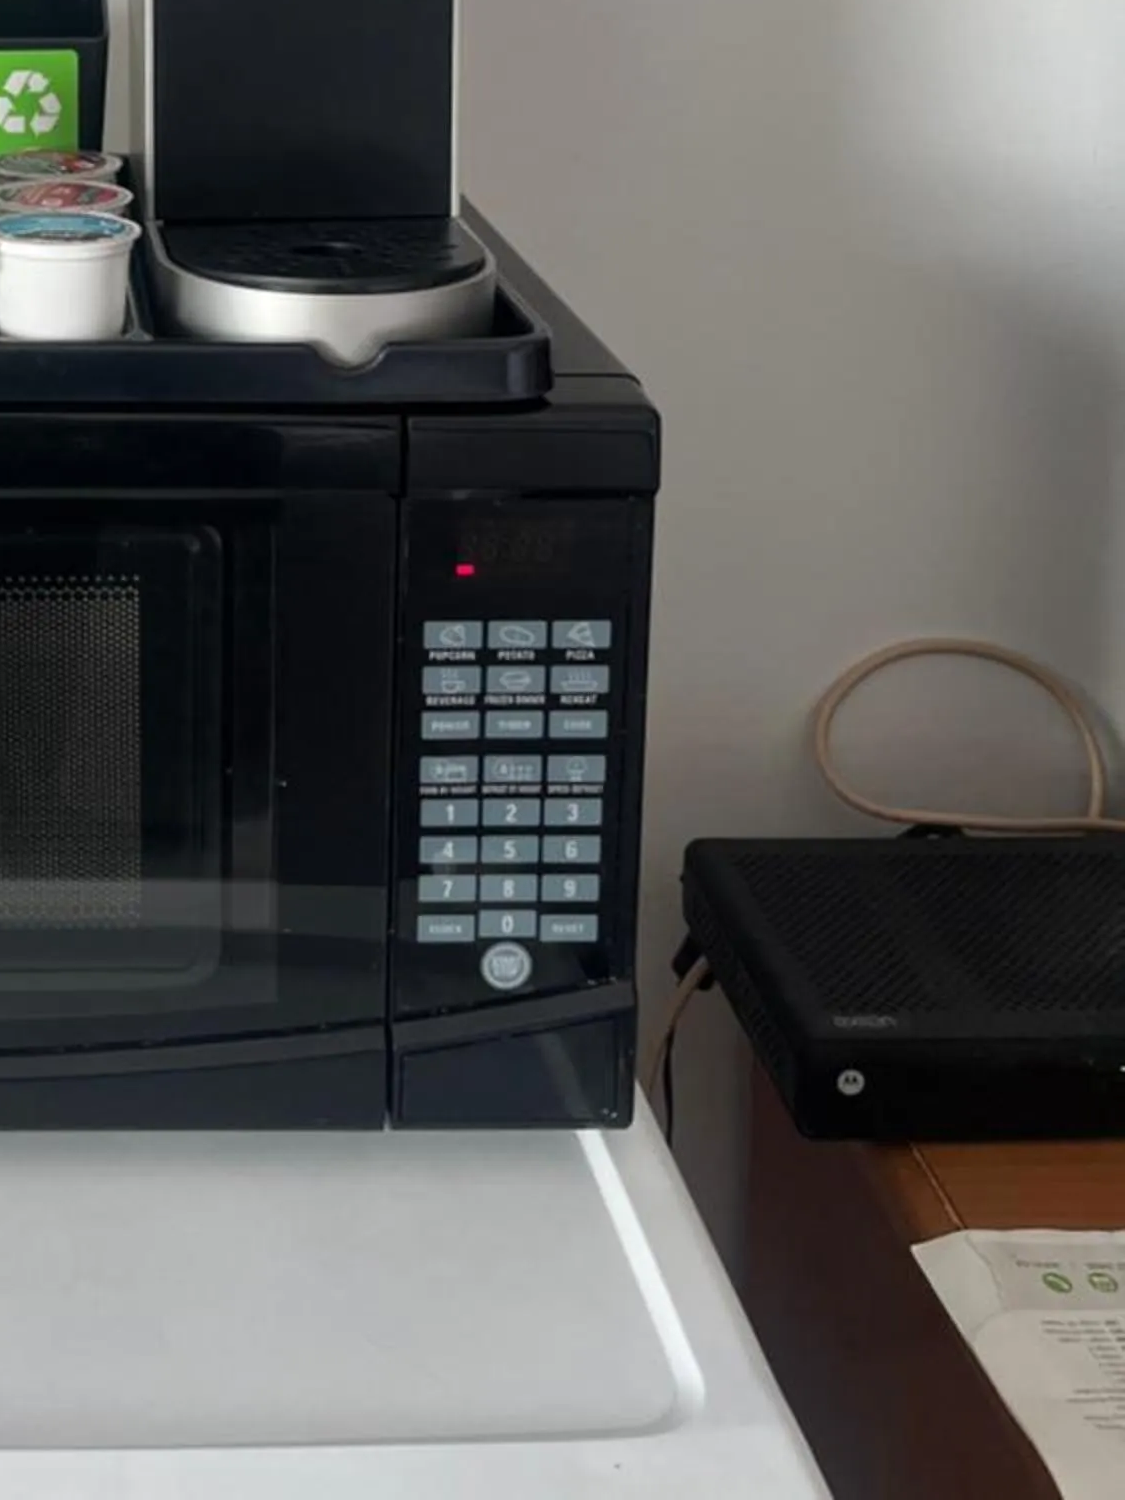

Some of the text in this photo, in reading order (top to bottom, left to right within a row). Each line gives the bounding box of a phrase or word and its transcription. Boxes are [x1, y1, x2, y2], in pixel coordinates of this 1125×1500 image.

[565, 650, 595, 661] PIZZA
[446, 803, 455, 824] 1
[505, 803, 518, 823] 2
[567, 802, 579, 822] 3
[442, 840, 454, 859] 4
[503, 840, 517, 859] 5
[565, 840, 578, 860] 6
[442, 879, 454, 899] 7
[502, 879, 515, 898] 8
[563, 879, 576, 898] 9
[501, 914, 514, 934] 0
